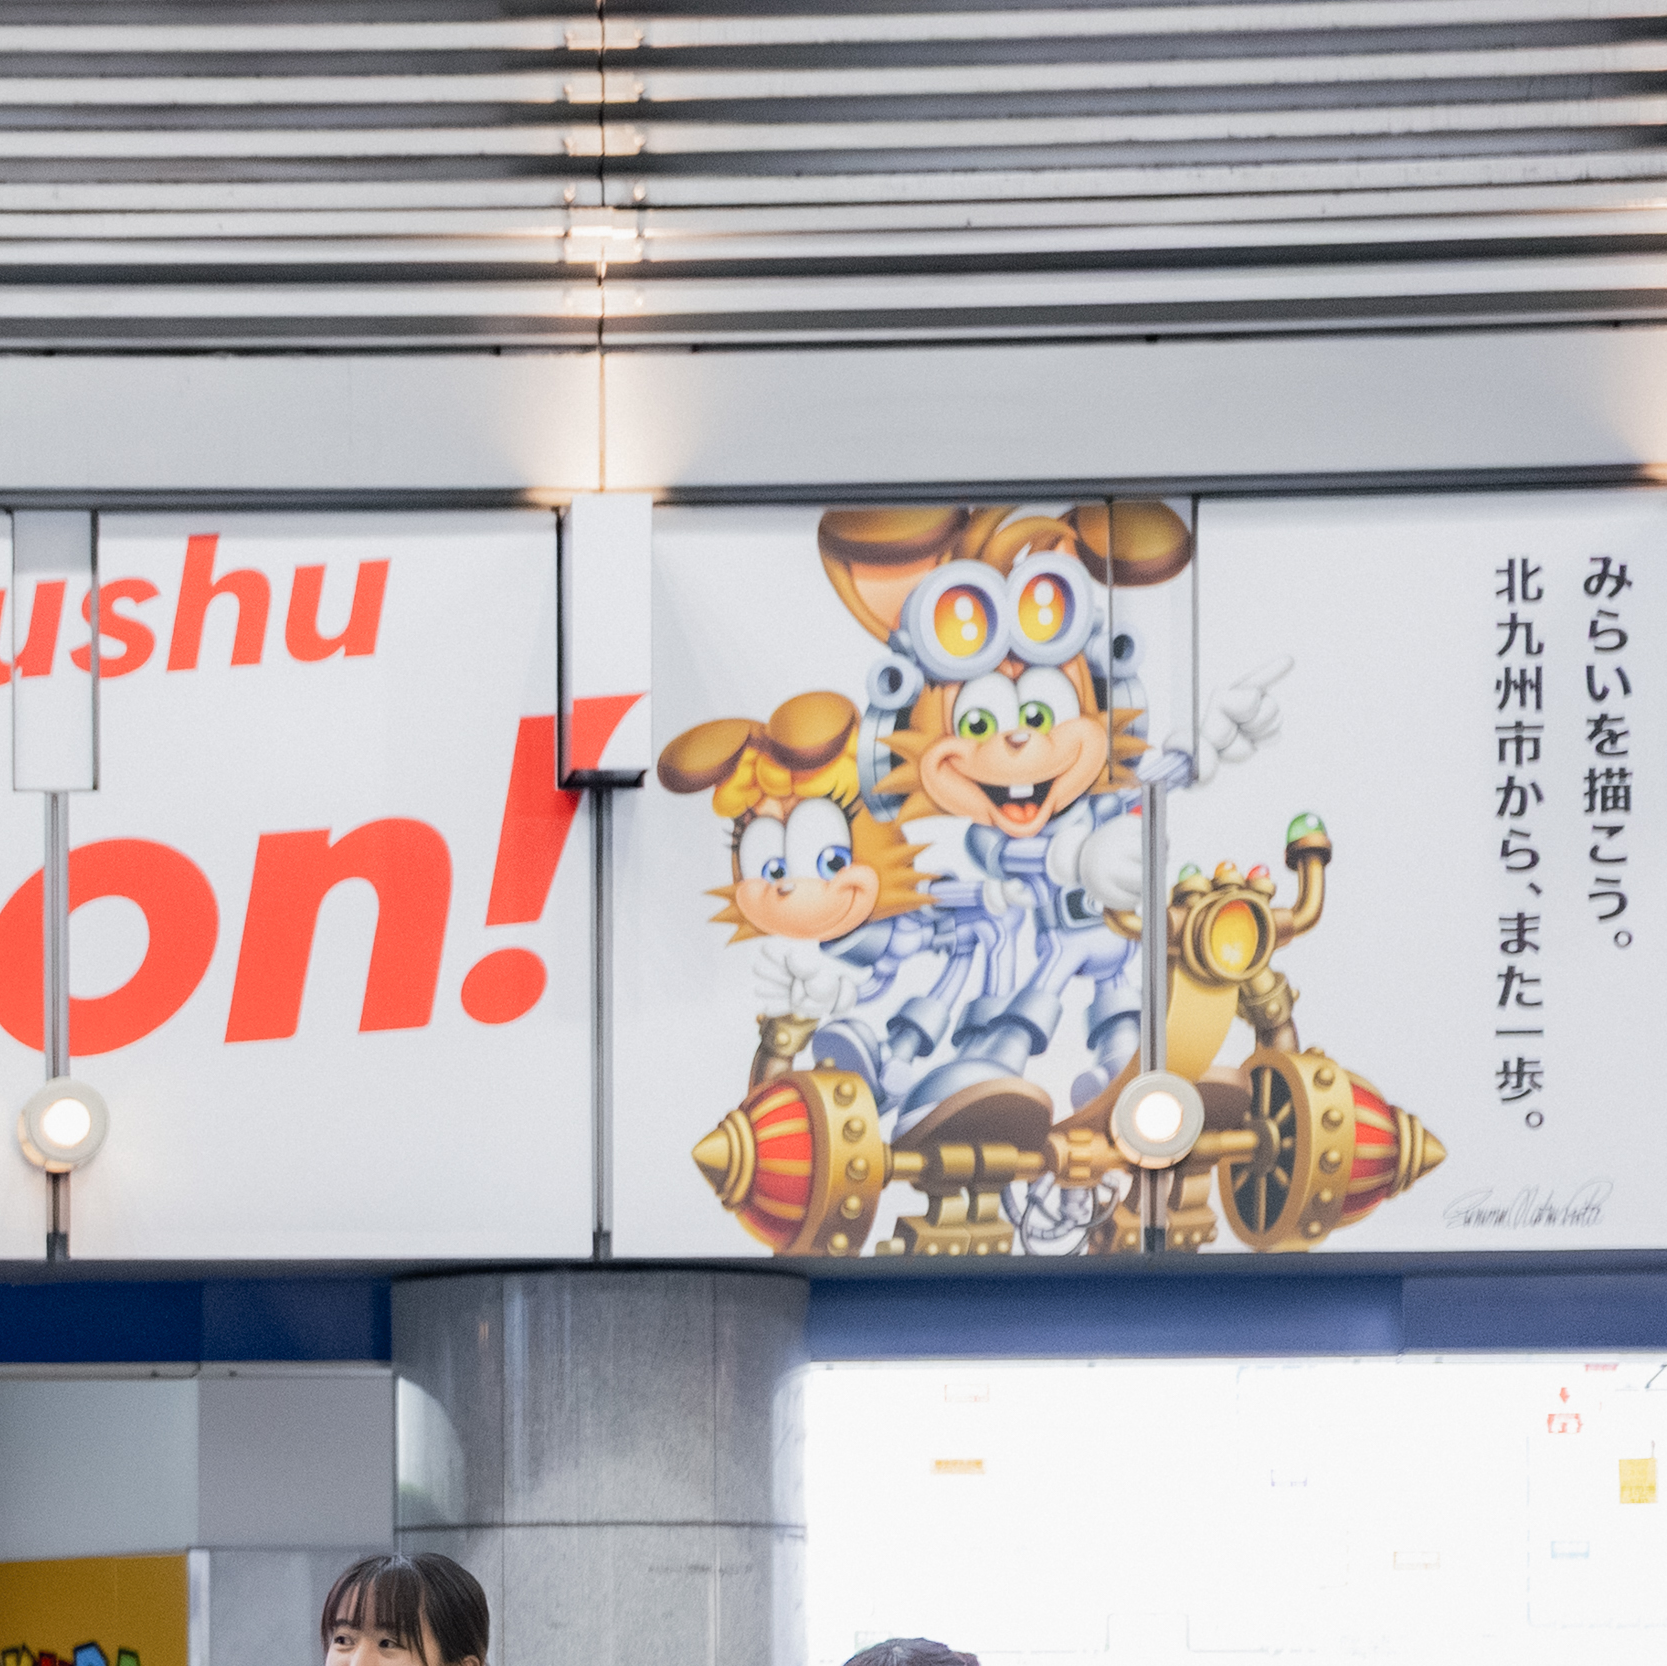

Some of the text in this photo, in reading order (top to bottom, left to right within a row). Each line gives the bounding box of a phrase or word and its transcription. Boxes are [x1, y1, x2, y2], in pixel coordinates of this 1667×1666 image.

[1494, 557, 1546, 1131] 北九州市から、また一歩。
[1583, 556, 1635, 951] みらいを描こう。
